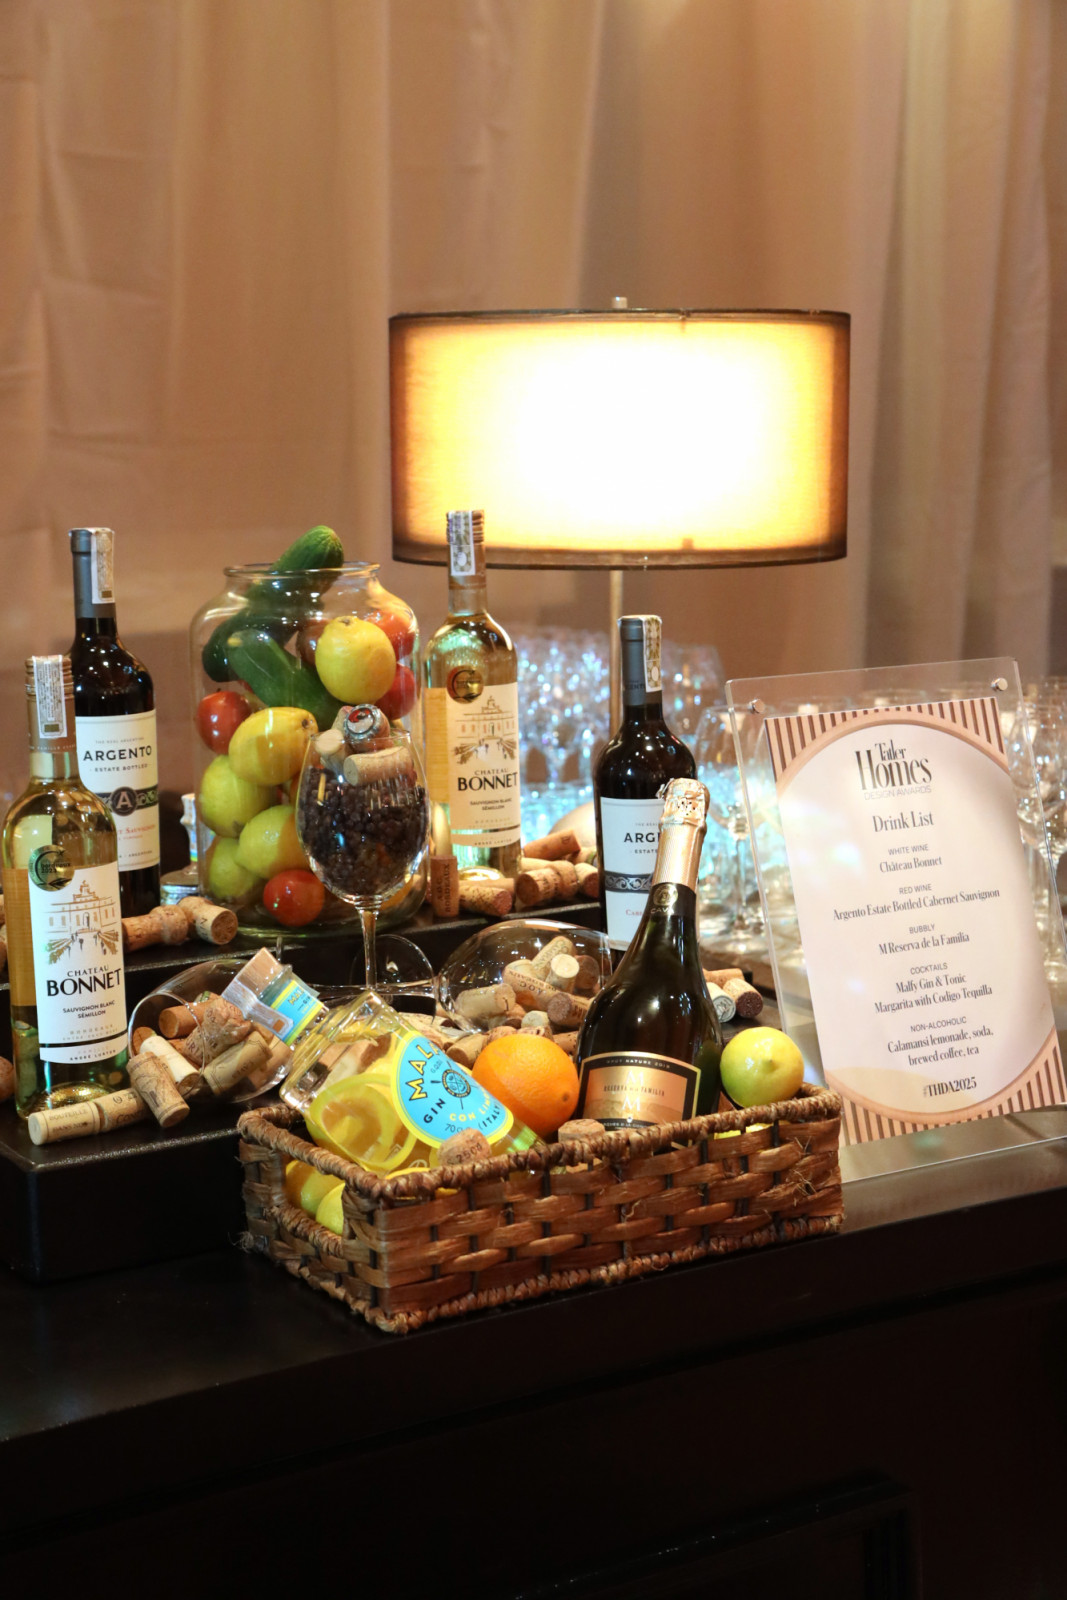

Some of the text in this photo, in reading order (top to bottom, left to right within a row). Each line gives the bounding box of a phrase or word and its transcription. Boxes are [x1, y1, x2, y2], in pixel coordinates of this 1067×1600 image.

[83, 745, 152, 761] ARGENTO
[122, 763, 148, 771] BOTTLED
[474, 768, 510, 776] CHATEAU
[855, 749, 932, 790] Homes
[457, 771, 518, 792] BONNET
[117, 792, 132, 809] A
[864, 784, 932, 801] DESIGN AWARDS
[872, 810, 934, 833] Drink List
[888, 843, 929, 856] WHITE WINE
[879, 856, 942, 873] Château Bonnet
[899, 883, 932, 895] RED WINE
[833, 889, 1000, 922] Argento Estate Bottled Cabernet Sauvignon
[909, 923, 935, 934] BUBBLY
[878, 931, 970, 955] M Reserva de la Familia
[67, 965, 109, 978] CHATEAU
[910, 962, 948, 975] COCKTAILS
[47, 968, 121, 997] BONNET
[895, 973, 967, 994] Malfy Gin & Tonic
[62, 1000, 115, 1014] SAUVIGNON BLANC
[874, 984, 993, 1014] Margarita with Codigo Tequilla
[910, 1016, 967, 1033] NON-ALCOHOLIC
[887, 1024, 994, 1054] Calamansi lemonade, soda,
[908, 1045, 980, 1067] brewed coffee, tea
[423, 1097, 446, 1124] GIN
[449, 1112, 476, 1122] CON
